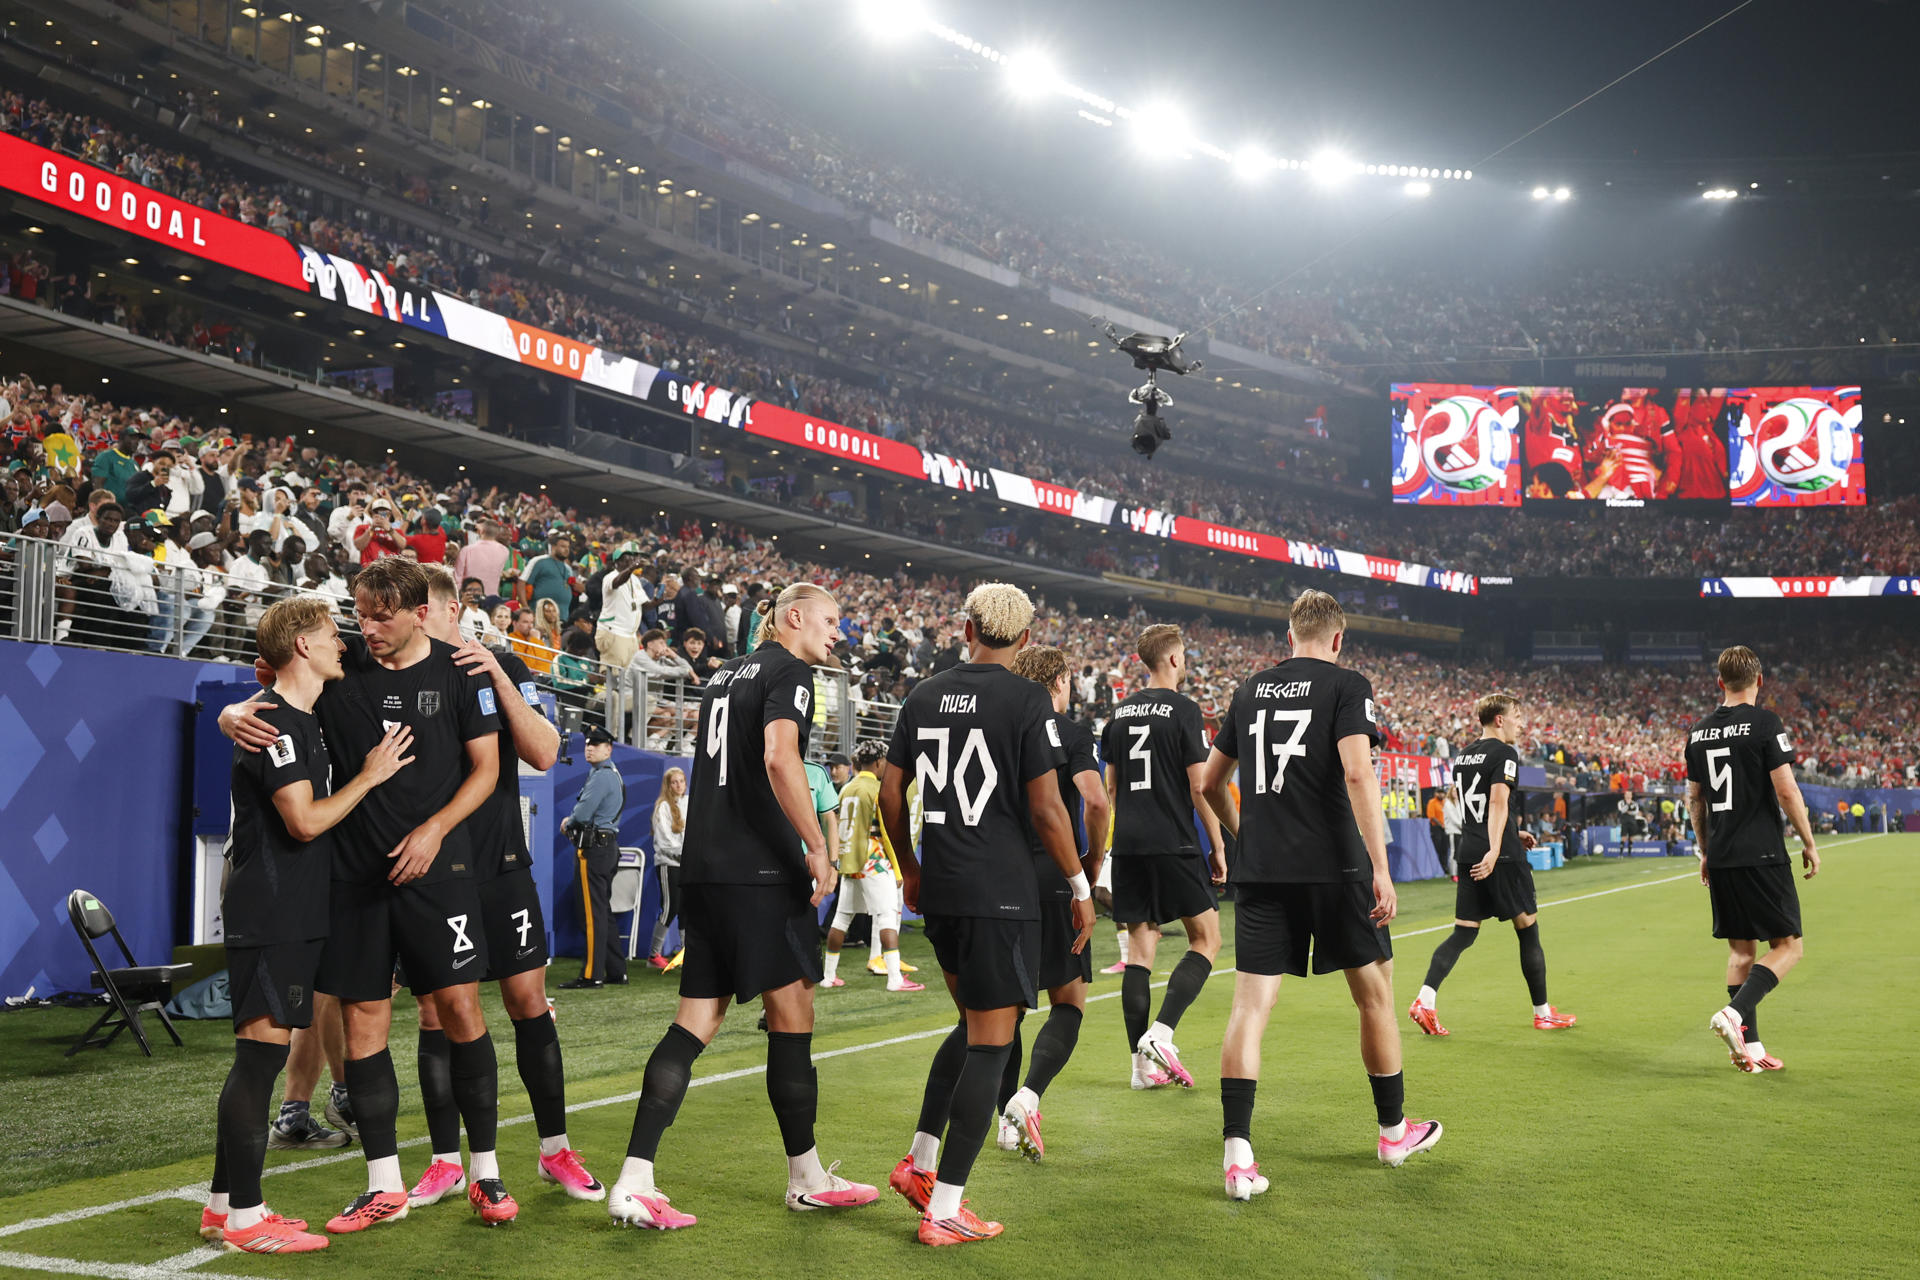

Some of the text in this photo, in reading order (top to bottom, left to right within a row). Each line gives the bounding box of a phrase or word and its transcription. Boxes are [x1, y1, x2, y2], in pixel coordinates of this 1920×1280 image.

[41, 161, 206, 247] GOOOOAL
[804, 422, 881, 461] GOOOOAL
[1207, 527, 1259, 552] GOOOOAL
[939, 694, 977, 714] NUSA
[1255, 681, 1313, 699] HEGGEM
[706, 693, 730, 787] 9
[1248, 709, 1313, 795] 17
[1723, 723, 1752, 739] WOLFE
[915, 727, 998, 827] 20
[1128, 724, 1152, 792] 3
[1706, 747, 1733, 813] 5
[1455, 771, 1487, 825] 16
[446, 914, 475, 954] 8
[511, 908, 533, 947] 7
